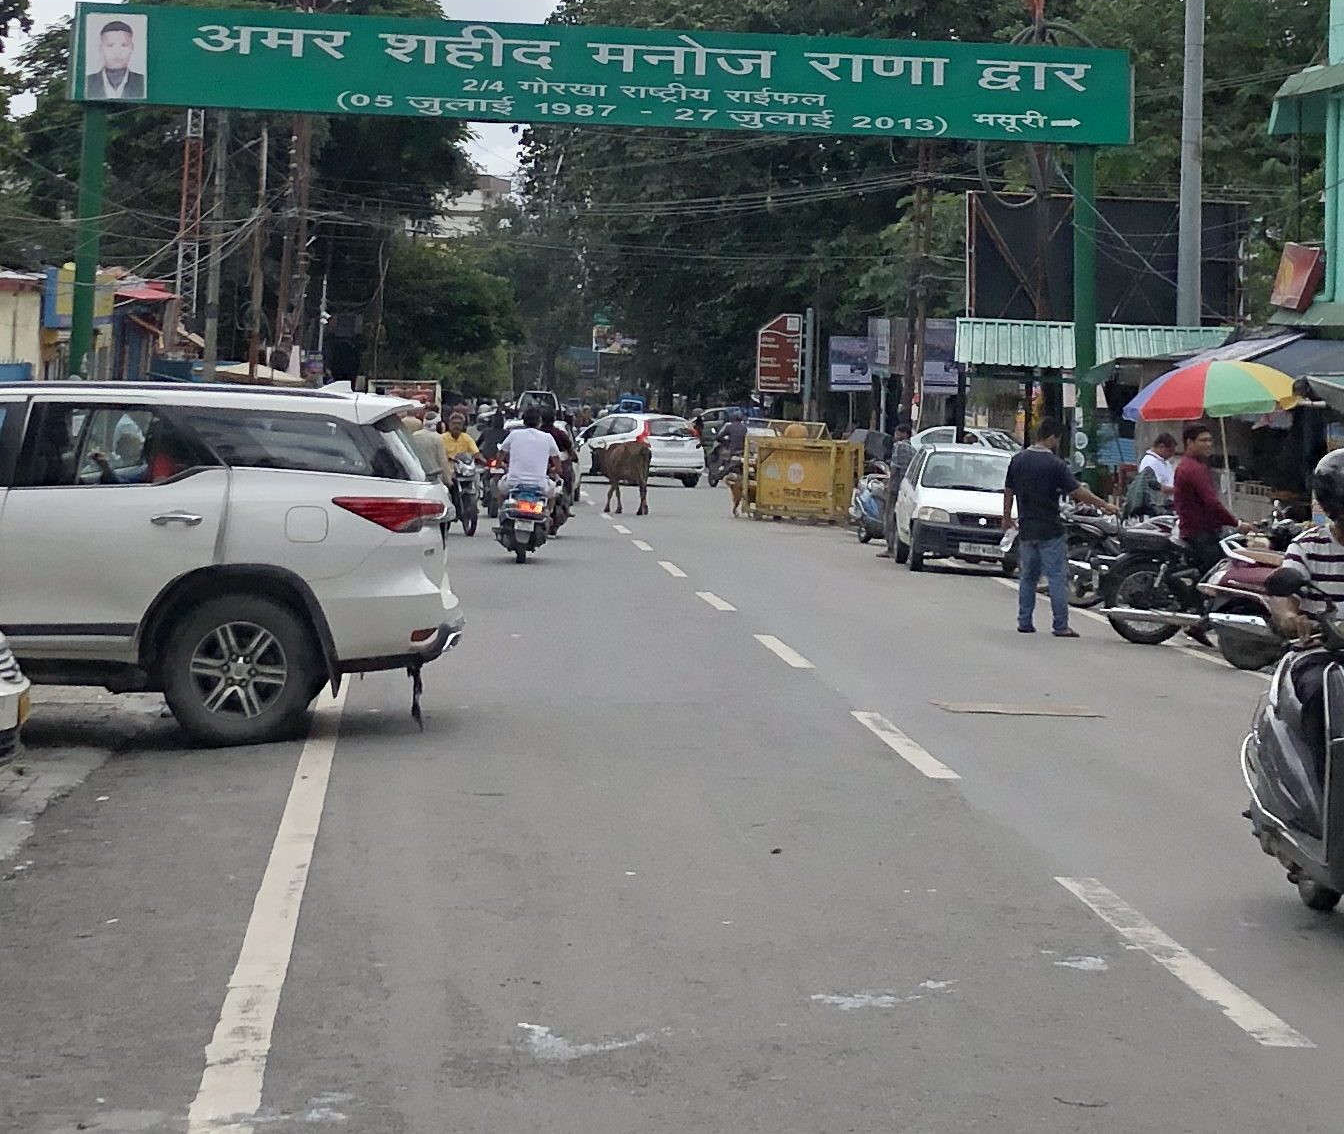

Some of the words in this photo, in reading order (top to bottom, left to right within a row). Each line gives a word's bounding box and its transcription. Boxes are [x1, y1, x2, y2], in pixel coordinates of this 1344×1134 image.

[193, 24, 351, 59] अमर
[379, 24, 561, 69] शहीद
[587, 35, 776, 78] मनोज
[804, 53, 949, 85] राणा
[977, 60, 1091, 91] द्वार
[463, 79, 504, 92] 2/4
[518, 77, 607, 96] गोरखा
[620, 83, 710, 102] राष्ट्रीय
[724, 88, 825, 106] राईफल
[337, 92, 392, 110] (05
[407, 96, 514, 115] जुलाई
[536, 103, 616, 116] 1987
[675, 109, 717, 120] 27
[727, 110, 833, 128] जुलाई
[853, 116, 947, 135] 2013)
[972, 111, 1047, 132] मसूरी
